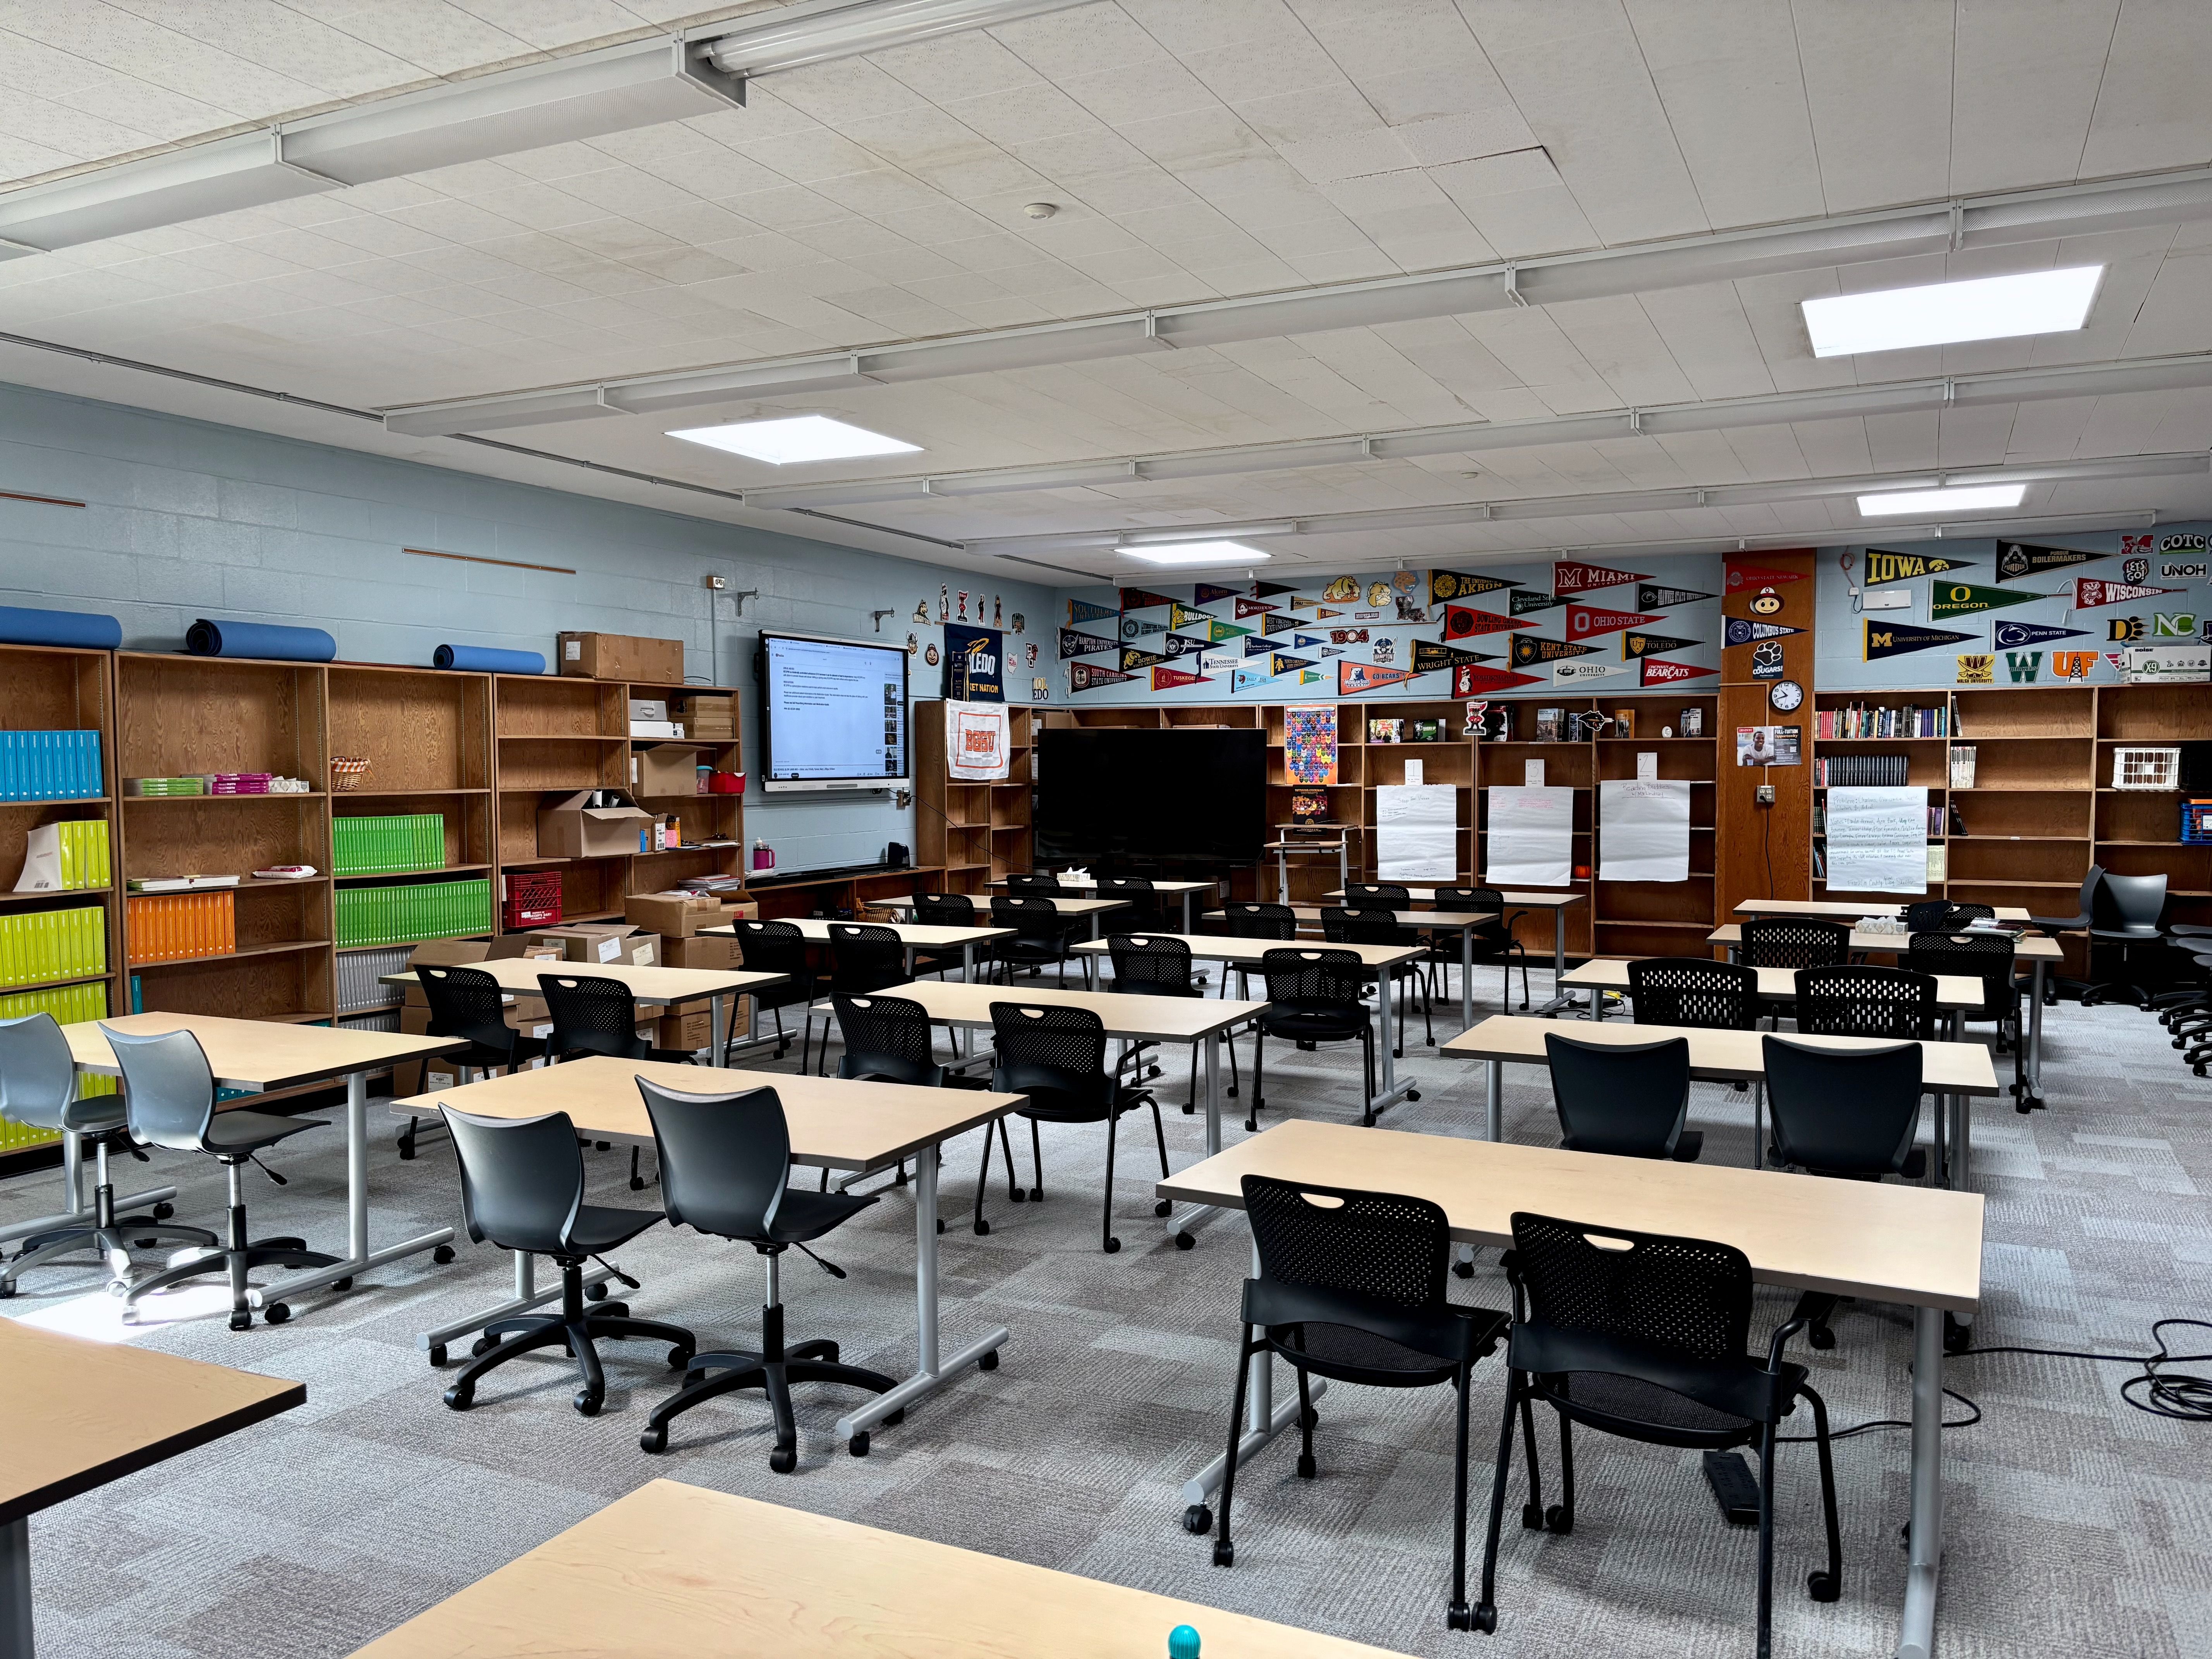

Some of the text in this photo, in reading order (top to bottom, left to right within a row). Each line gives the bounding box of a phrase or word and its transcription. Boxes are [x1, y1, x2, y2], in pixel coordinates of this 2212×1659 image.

[2160, 534, 2204, 551] COTC
[2032, 554, 2086, 563] BOILERMAKERS
[1867, 553, 1925, 583] IOWA
[2004, 563, 2025, 572] PURDUE
[2126, 560, 2145, 573] LET'S
[2161, 563, 2206, 576] UNOH
[1558, 568, 1582, 587] M
[1588, 569, 1635, 582] MIAMI
[2127, 570, 2144, 581] GO!
[1458, 582, 1502, 596] AKRON
[1950, 586, 1970, 601] O
[2106, 583, 2162, 602] WISCONSIN
[1675, 591, 1685, 601] STATE
[1477, 613, 1501, 623] BOWLING
[1574, 612, 1590, 632] O
[1594, 616, 1645, 627] OHIO STATE
[1475, 623, 1523, 632] STATE UNIVERSITY
[2154, 613, 2195, 635] NC
[1753, 622, 1779, 639] COLUMBUS
[1079, 636, 1096, 644] HAMPTON
[1331, 630, 1369, 644] 1904
[1872, 632, 1892, 647] M
[1540, 642, 1561, 651] KENT
[1138, 655, 1157, 663] BOWIE
[1542, 650, 1587, 659] UNIVERSITY
[1418, 659, 1452, 670] WRIGHT
[1753, 665, 1783, 675] COUGARS!
[2052, 652, 2098, 677] UF
[1091, 668, 1106, 677] SOUTH
[1473, 673, 1518, 682] Youngstown
[1646, 669, 1689, 678] BEARCATS
[979, 684, 998, 693] NATION
[1033, 689, 1049, 700] EDO
[965, 729, 996, 752] BGSU
[1640, 755, 1654, 772] 2
[1530, 762, 1539, 777] 3
[1833, 796, 1857, 805] Problem:
